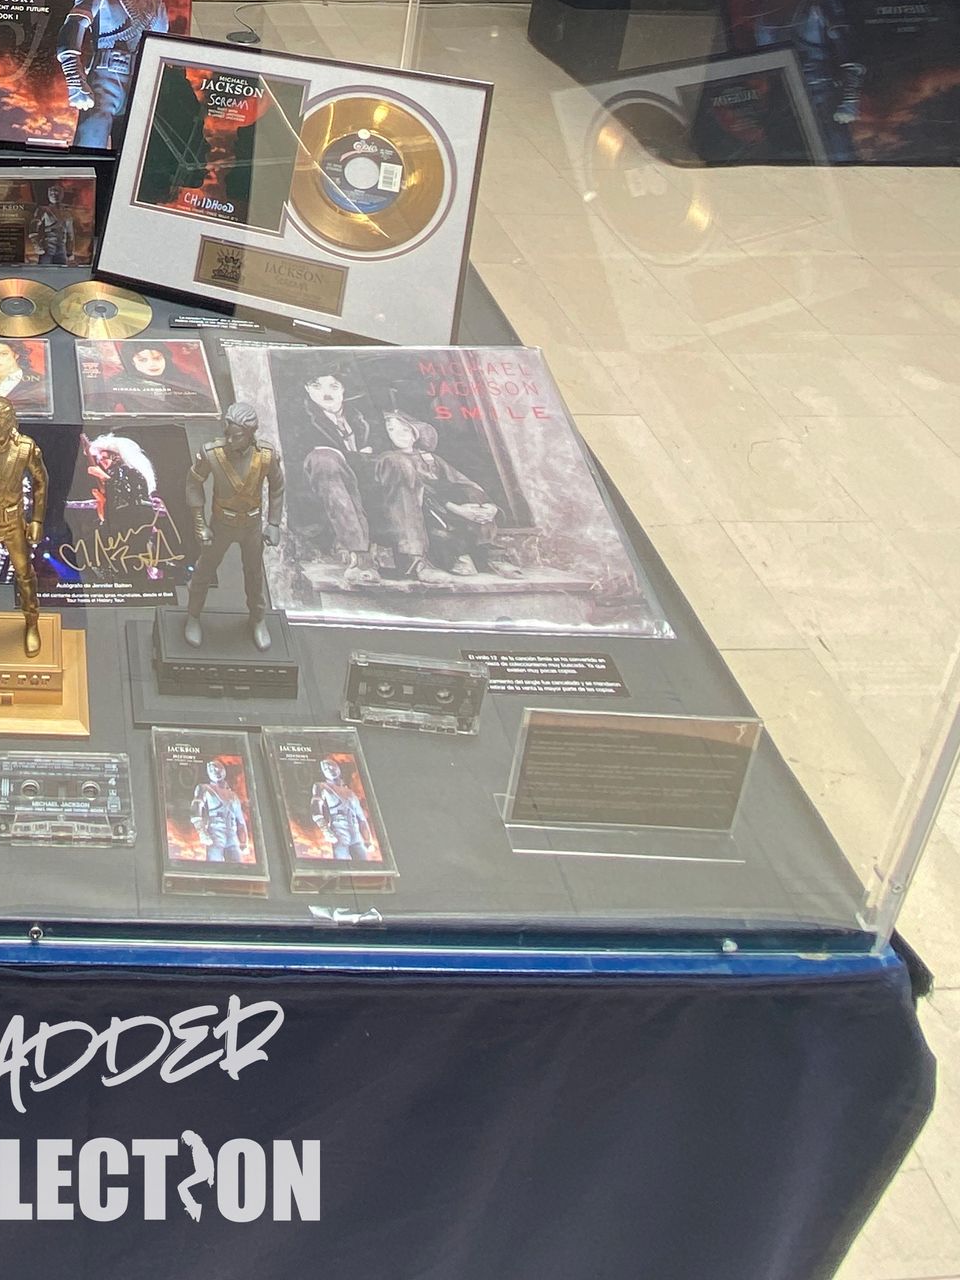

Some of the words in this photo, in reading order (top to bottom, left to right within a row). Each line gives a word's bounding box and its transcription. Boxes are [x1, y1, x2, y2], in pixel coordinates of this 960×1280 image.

[200, 79, 264, 98] JACKSON
[219, 76, 248, 86] MICHAEL
[264, 261, 324, 284] JACKSON
[418, 362, 532, 376] MICHAEL
[426, 380, 539, 396] JACKSON
[434, 405, 551, 420] SMILE
